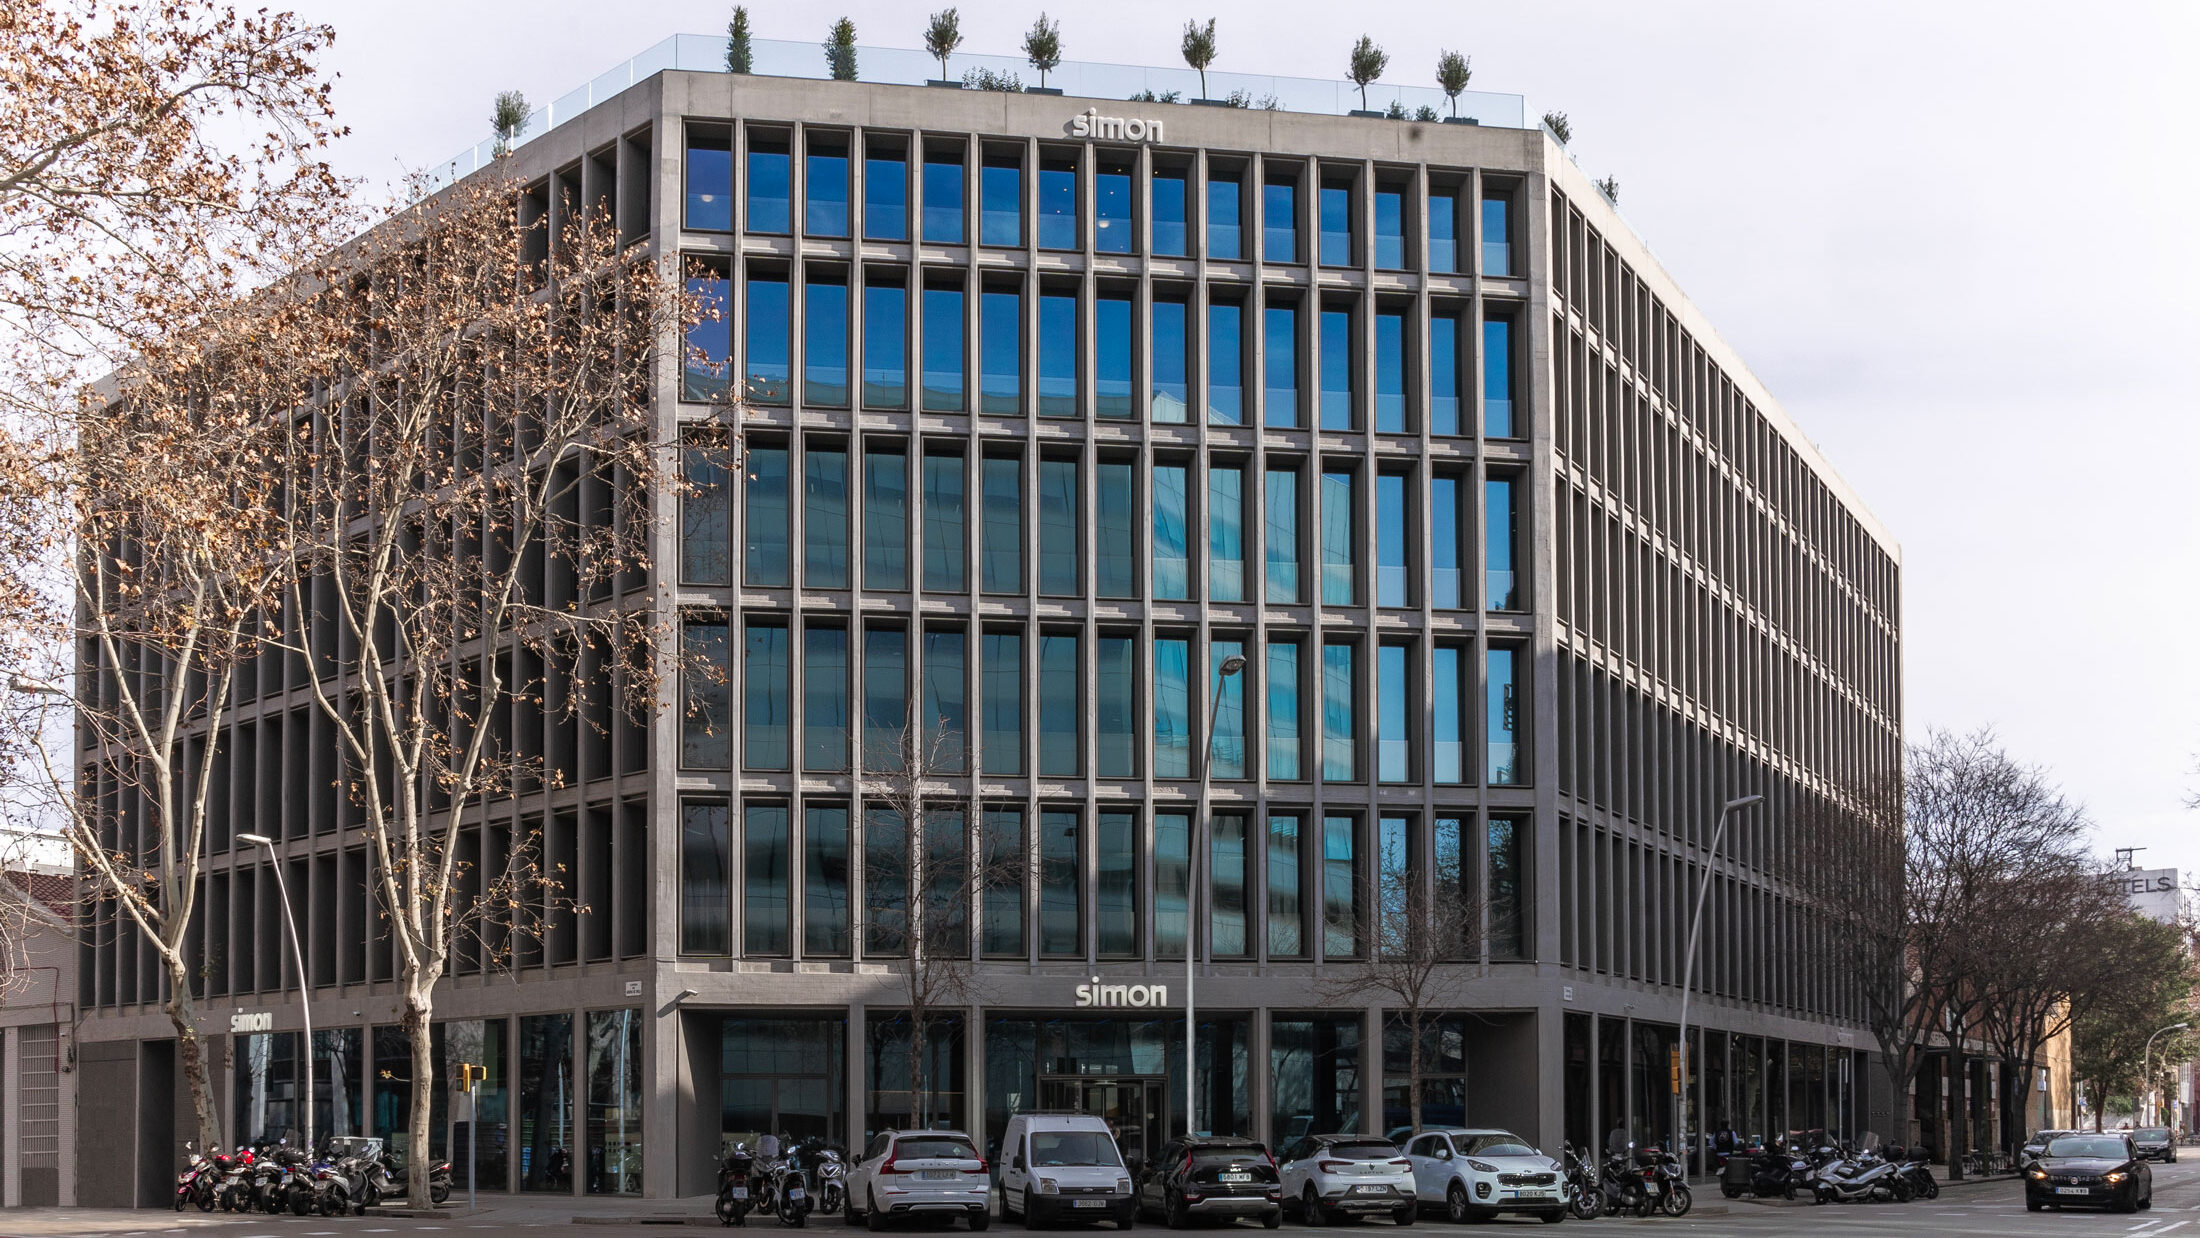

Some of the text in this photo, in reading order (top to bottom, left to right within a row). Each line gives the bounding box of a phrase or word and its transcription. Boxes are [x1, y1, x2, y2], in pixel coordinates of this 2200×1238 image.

[1073, 107, 1163, 142] simon
[1076, 976, 1167, 1007] simon
[231, 1008, 272, 1032] simon
